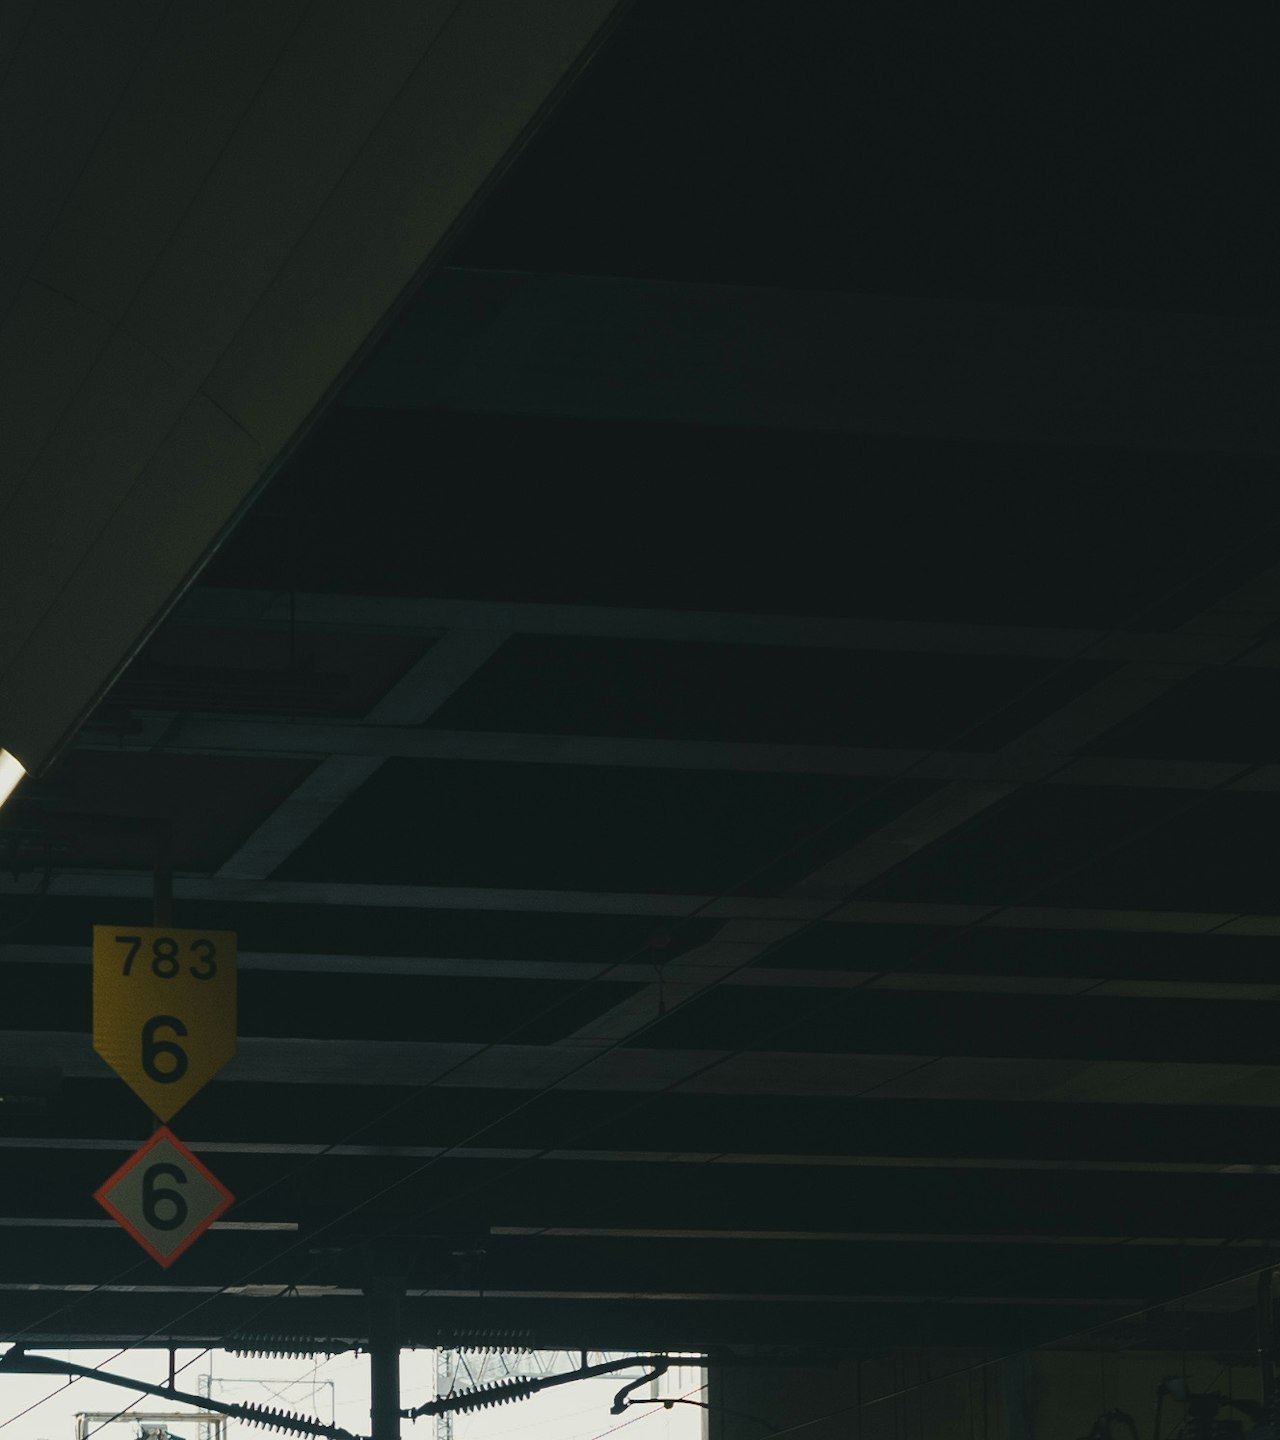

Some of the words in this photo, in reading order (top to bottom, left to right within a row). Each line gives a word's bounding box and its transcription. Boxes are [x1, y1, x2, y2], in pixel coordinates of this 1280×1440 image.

[115, 935, 218, 981] 783
[141, 1014, 189, 1085] 6
[141, 1162, 188, 1232] 6
